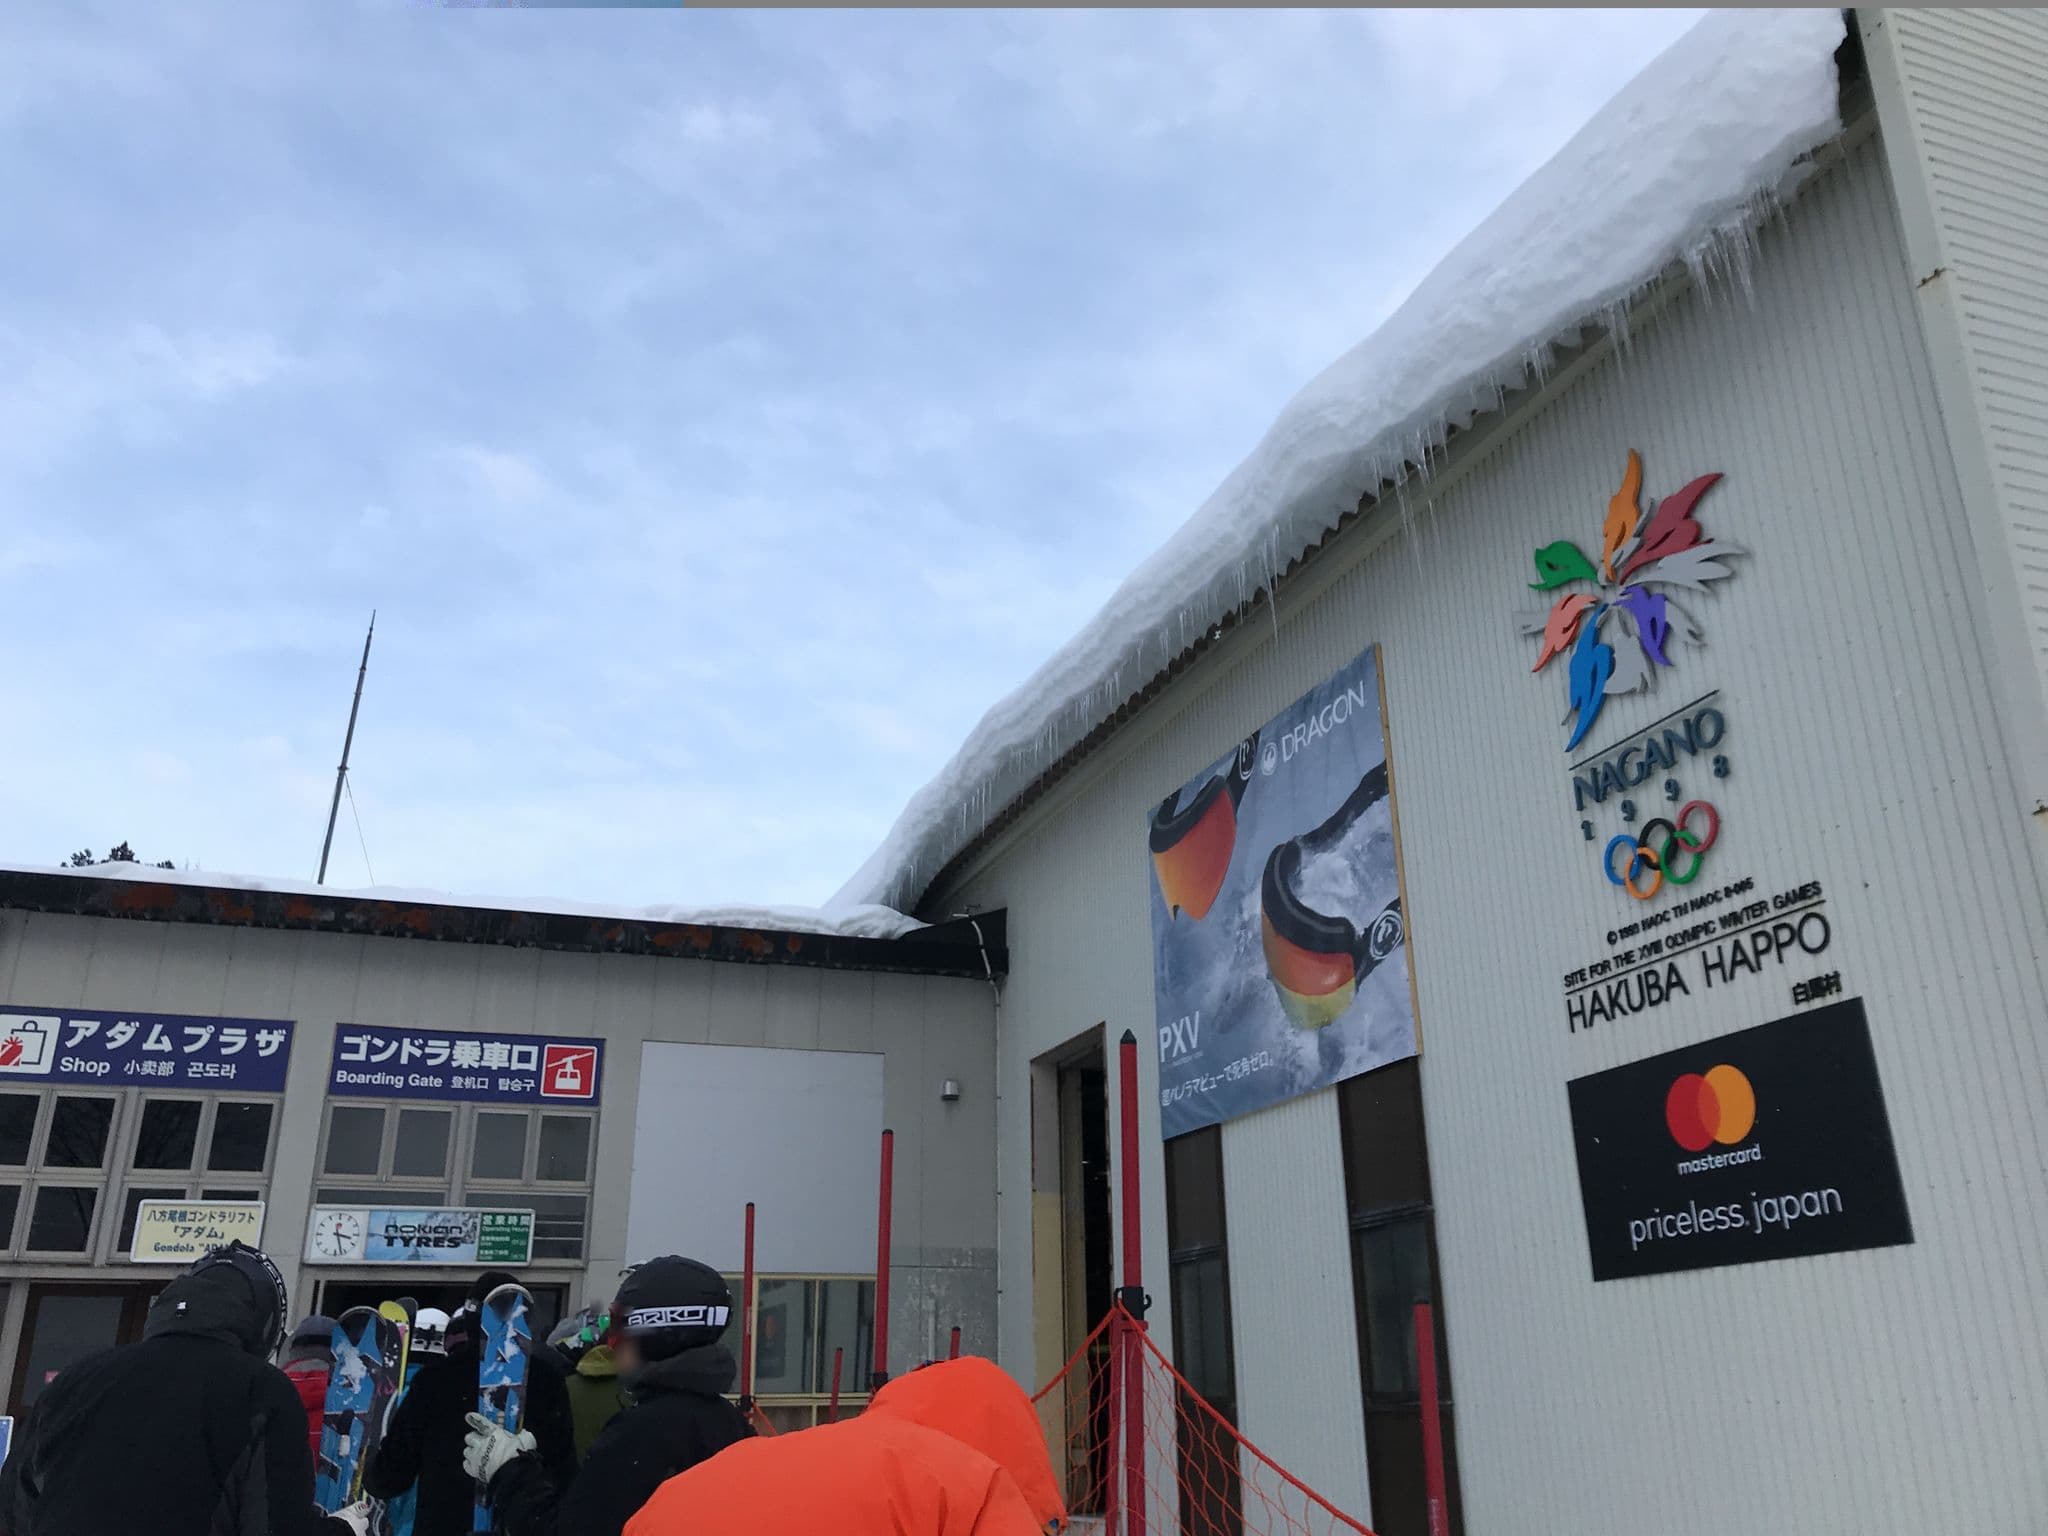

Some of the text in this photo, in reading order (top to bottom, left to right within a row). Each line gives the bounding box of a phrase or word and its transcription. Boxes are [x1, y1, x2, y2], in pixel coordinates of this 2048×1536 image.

[1282, 680, 1365, 763] DRAGON
[1573, 707, 1725, 811] NAGANO
[1564, 968, 1587, 988] SITE
[1589, 960, 1612, 978] FOR
[1613, 950, 1636, 968] THE
[1665, 920, 1717, 949] OLYMPIC
[1718, 900, 1770, 930] WINTER
[1773, 881, 1823, 910] GAMES
[1566, 912, 1831, 1033] HAKUBA HAPPO
[65, 1020, 287, 1057] アダムプラザ
[340, 1035, 539, 1071] ゴンドラ乗車口
[1160, 1011, 1200, 1063] PXV
[60, 1056, 110, 1077] Shop
[187, 1062, 237, 1079] 곤도라
[336, 1070, 404, 1088] Boarding
[408, 1074, 443, 1088] Gate
[1677, 1144, 1762, 1175] mastercard
[154, 1242, 195, 1253] Gondola
[174, 1225, 225, 1239] 「アダム」
[384, 1236, 461, 1248] TYRES
